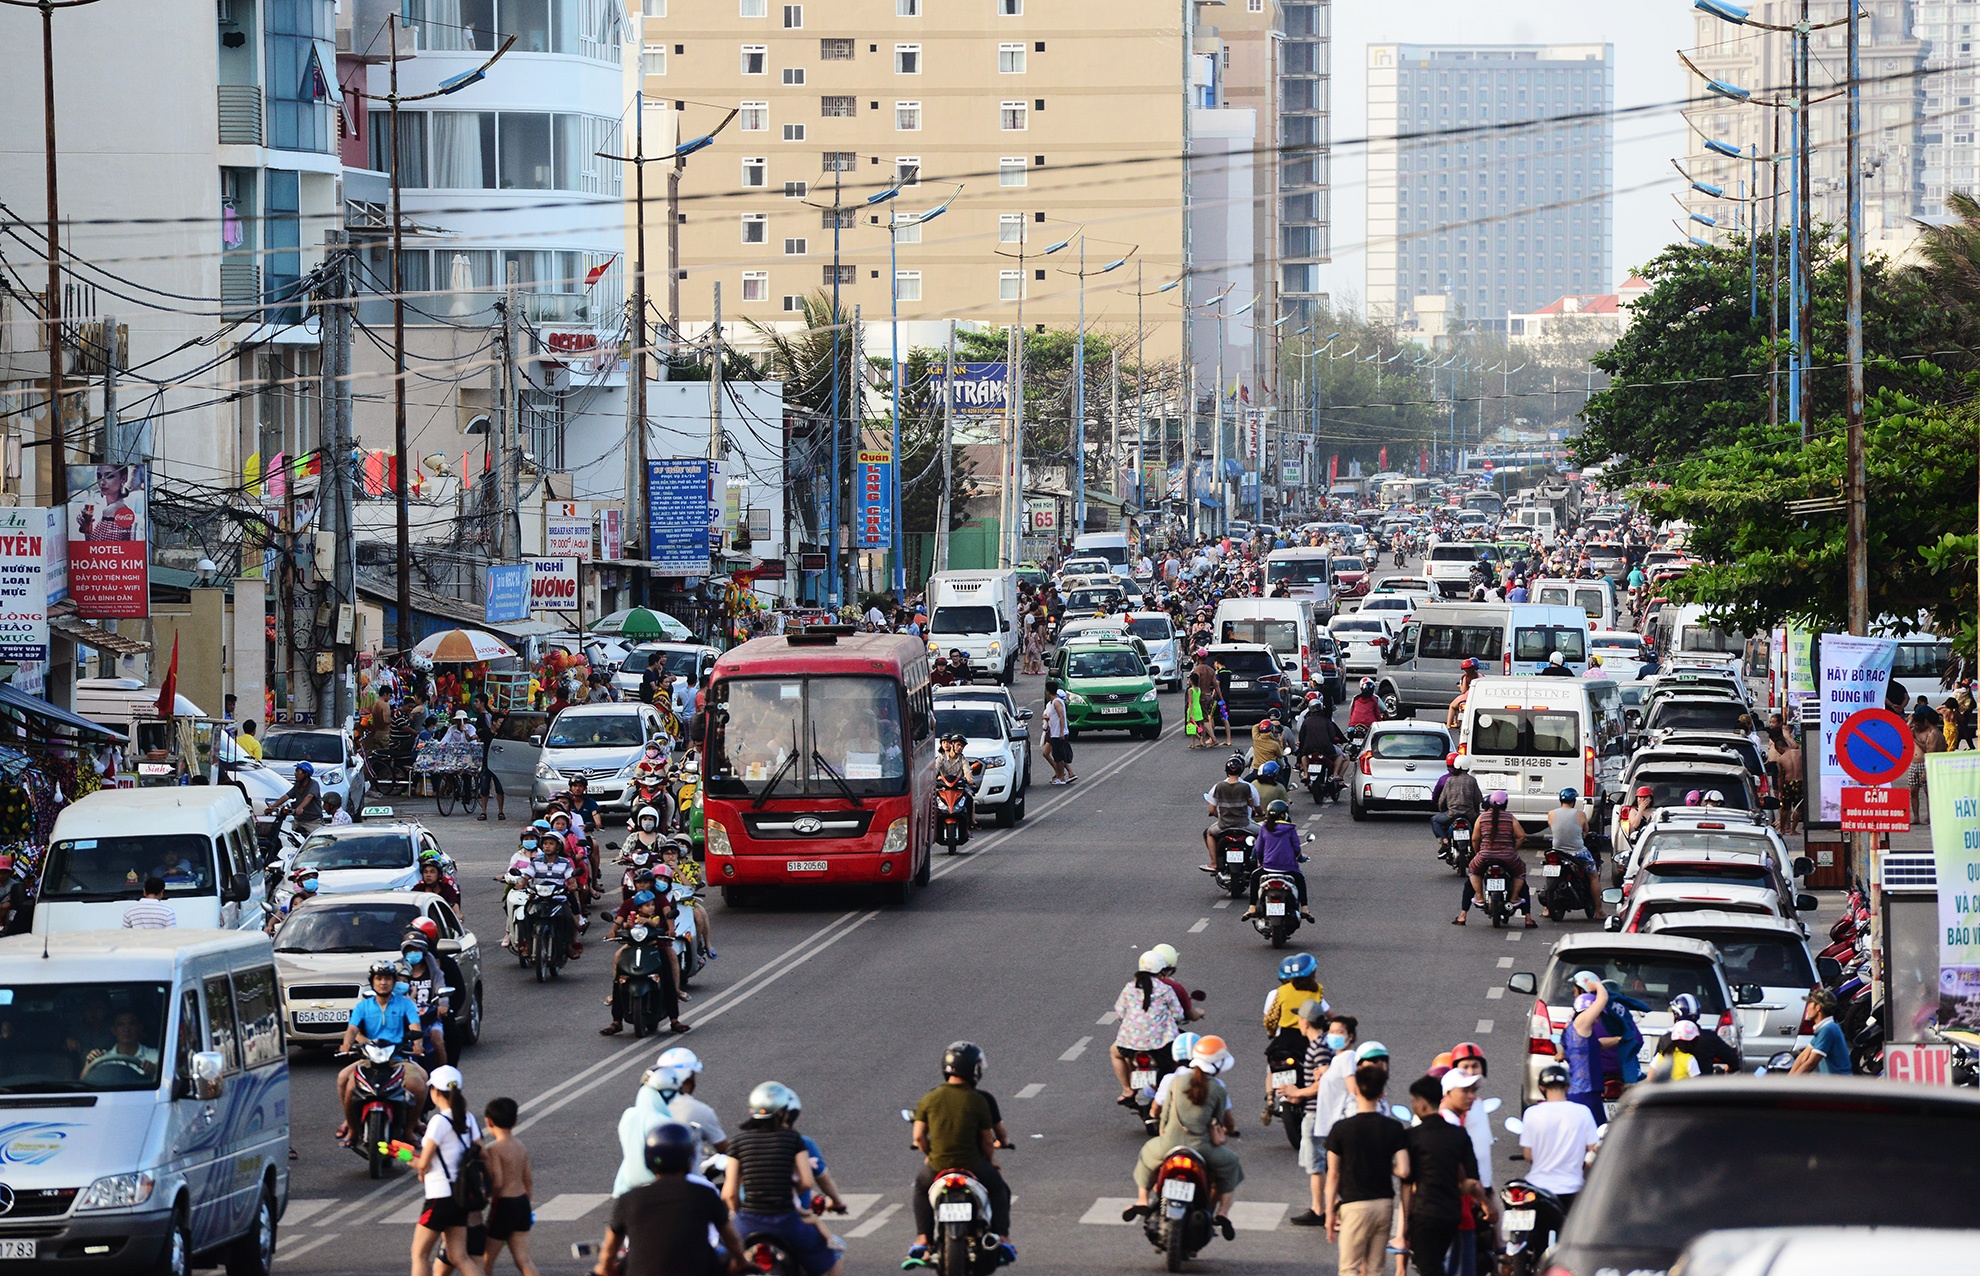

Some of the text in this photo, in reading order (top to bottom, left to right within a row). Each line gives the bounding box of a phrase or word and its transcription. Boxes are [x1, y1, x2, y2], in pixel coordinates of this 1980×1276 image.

[860, 452, 889, 462] Quán
[866, 464, 881, 501] LONG
[1035, 511, 1054, 527] 65
[549, 527, 590, 535] BREAKFAST BUFFET
[0, 531, 42, 556] YÊN
[89, 545, 124, 554] MOTEL
[1, 564, 41, 573] NƯỚNG
[71, 557, 144, 570] HOÀNG KIM
[535, 559, 564, 572] NGHỈ
[2, 578, 30, 586] LOẠI
[1, 588, 27, 597] MỰC
[1827, 665, 1886, 682] HÃY BỎ RÁC
[1485, 688, 1570, 698] LIMOUSINE
[1831, 688, 1860, 703] ĐÚNG
[1864, 788, 1888, 803] CẤM
[1955, 796, 1977, 818] HÃY
[1955, 891, 1970, 914] VÀ
[1947, 921, 1970, 946] BẢO
